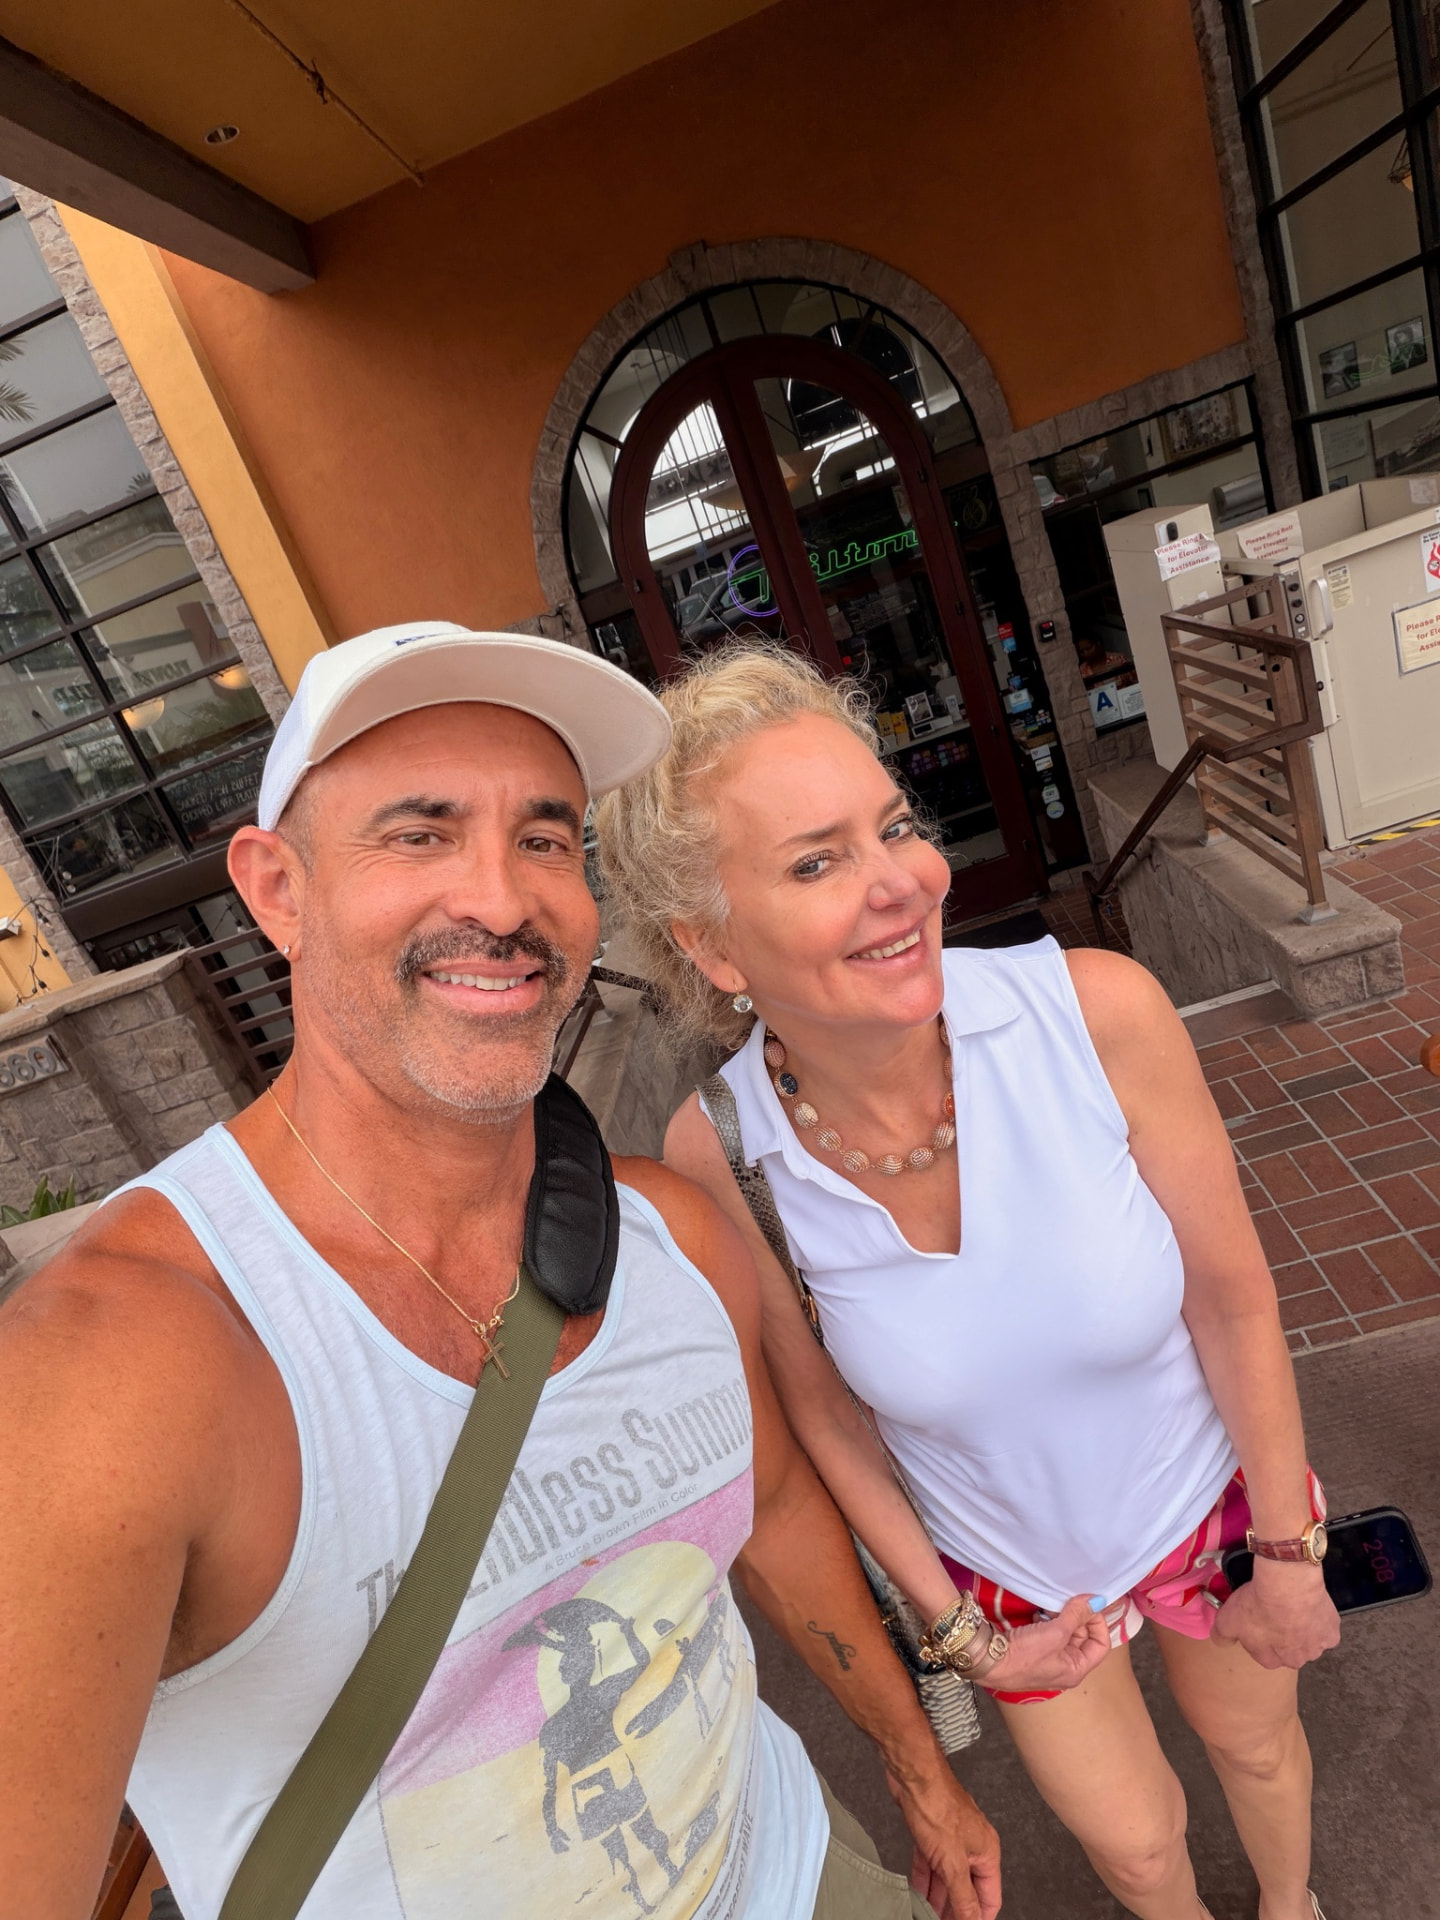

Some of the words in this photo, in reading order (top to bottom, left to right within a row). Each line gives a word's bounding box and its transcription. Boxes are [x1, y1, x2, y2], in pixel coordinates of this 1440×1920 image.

[1156, 543, 1181, 556] Please
[1181, 536, 1199, 546] Ring
[1167, 555, 1178, 564] for
[1178, 544, 1208, 559] Elevator
[1170, 556, 1210, 574] Assistance
[1406, 618, 1434, 632] Please
[1416, 632, 1428, 640] for
[1096, 691, 1114, 712] A
[231, 772, 259, 792] BUFFET
[181, 804, 213, 824] CHOPPED
[544, 1562, 554, 1572] A
[555, 1541, 591, 1566] Bruce
[592, 1519, 630, 1545] Brown
[631, 1504, 657, 1524] Film
[670, 1483, 699, 1503] Color
[356, 1559, 406, 1639] Th
[465, 1442, 643, 1601] ndless
